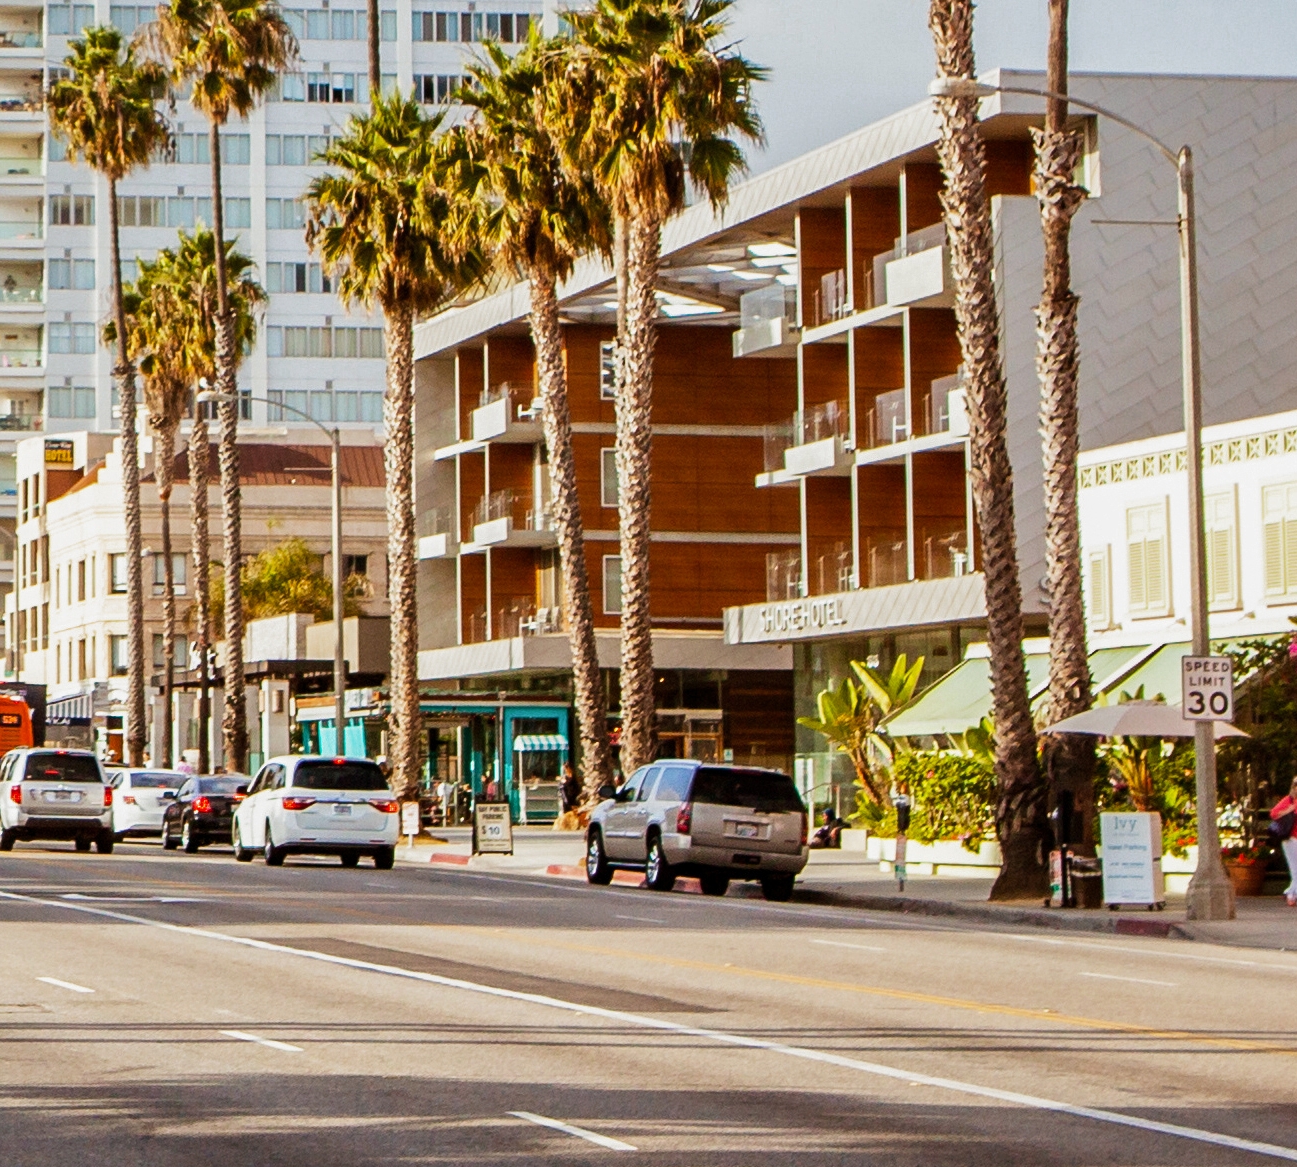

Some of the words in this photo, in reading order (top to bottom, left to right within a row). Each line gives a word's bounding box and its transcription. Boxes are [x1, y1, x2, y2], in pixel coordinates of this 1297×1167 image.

[1185, 661, 1230, 672] SPEED
[1189, 676, 1225, 687] LIMIT
[1188, 691, 1229, 716] 30
[1113, 816, 1137, 832] Ivy
